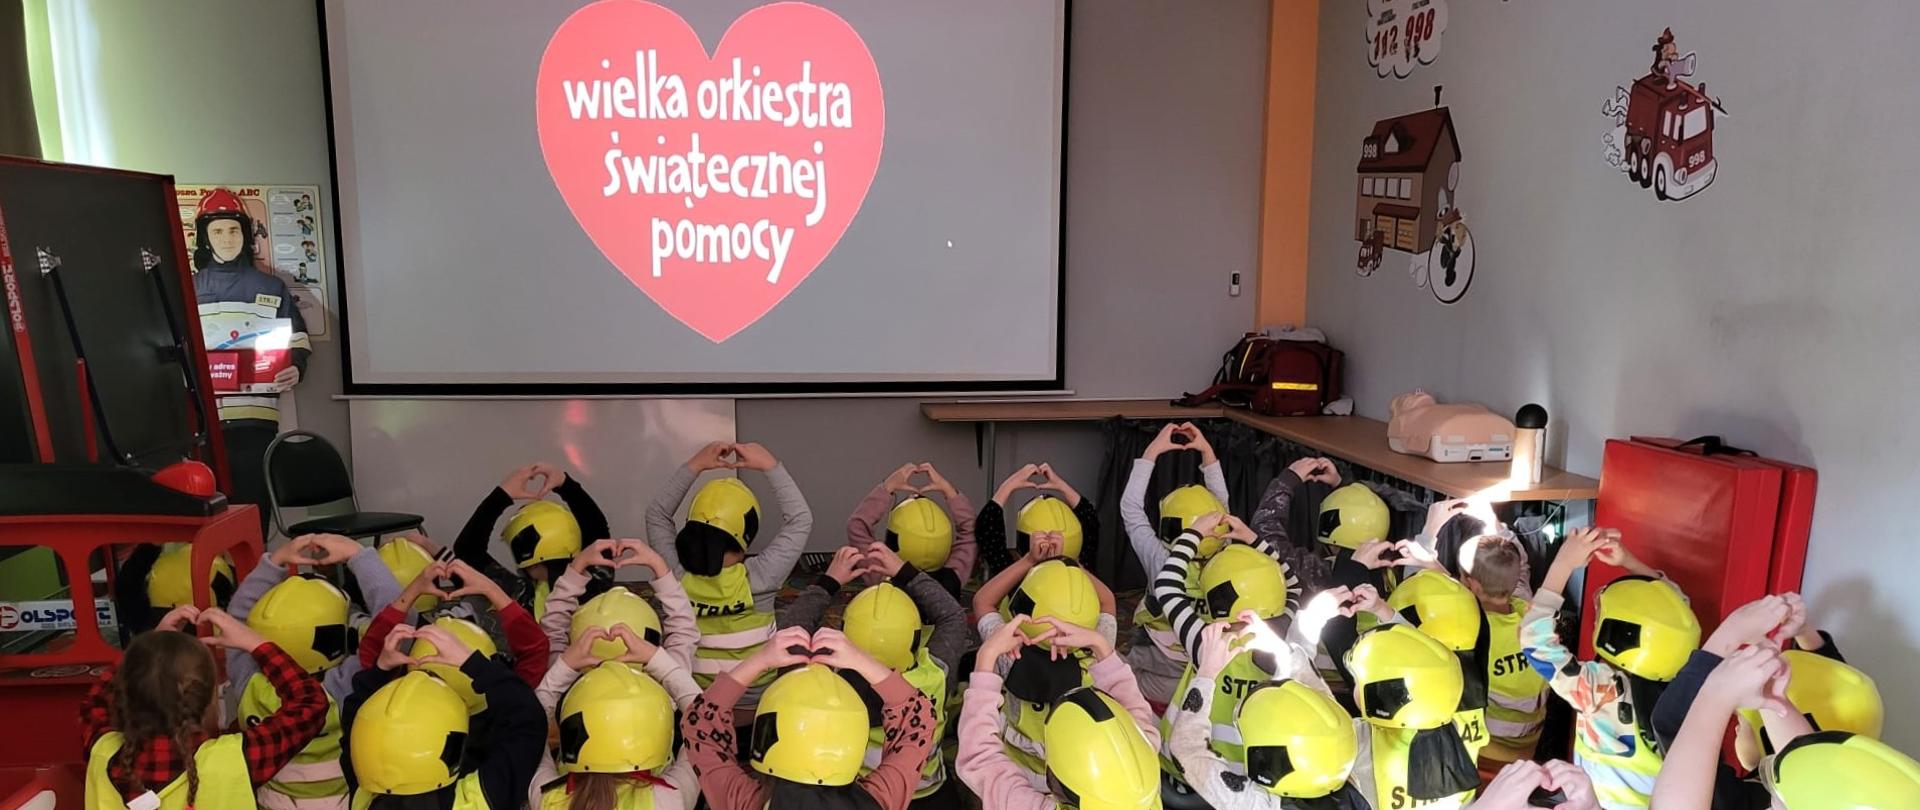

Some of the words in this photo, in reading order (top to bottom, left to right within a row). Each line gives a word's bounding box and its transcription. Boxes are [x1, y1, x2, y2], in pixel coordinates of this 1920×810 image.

[1374, 25, 1398, 60] 112
[1406, 8, 1436, 48] 998
[562, 49, 689, 120] wielka
[696, 57, 853, 129] orkiestra
[1363, 143, 1378, 159] 998
[1688, 150, 1706, 168] 998
[603, 131, 827, 227] świątecznej
[238, 188, 260, 197] ABC
[651, 217, 795, 284] pomocy
[213, 362, 236, 370] adres
[690, 599, 746, 617] TRAŻ
[1493, 652, 1530, 676] STR
